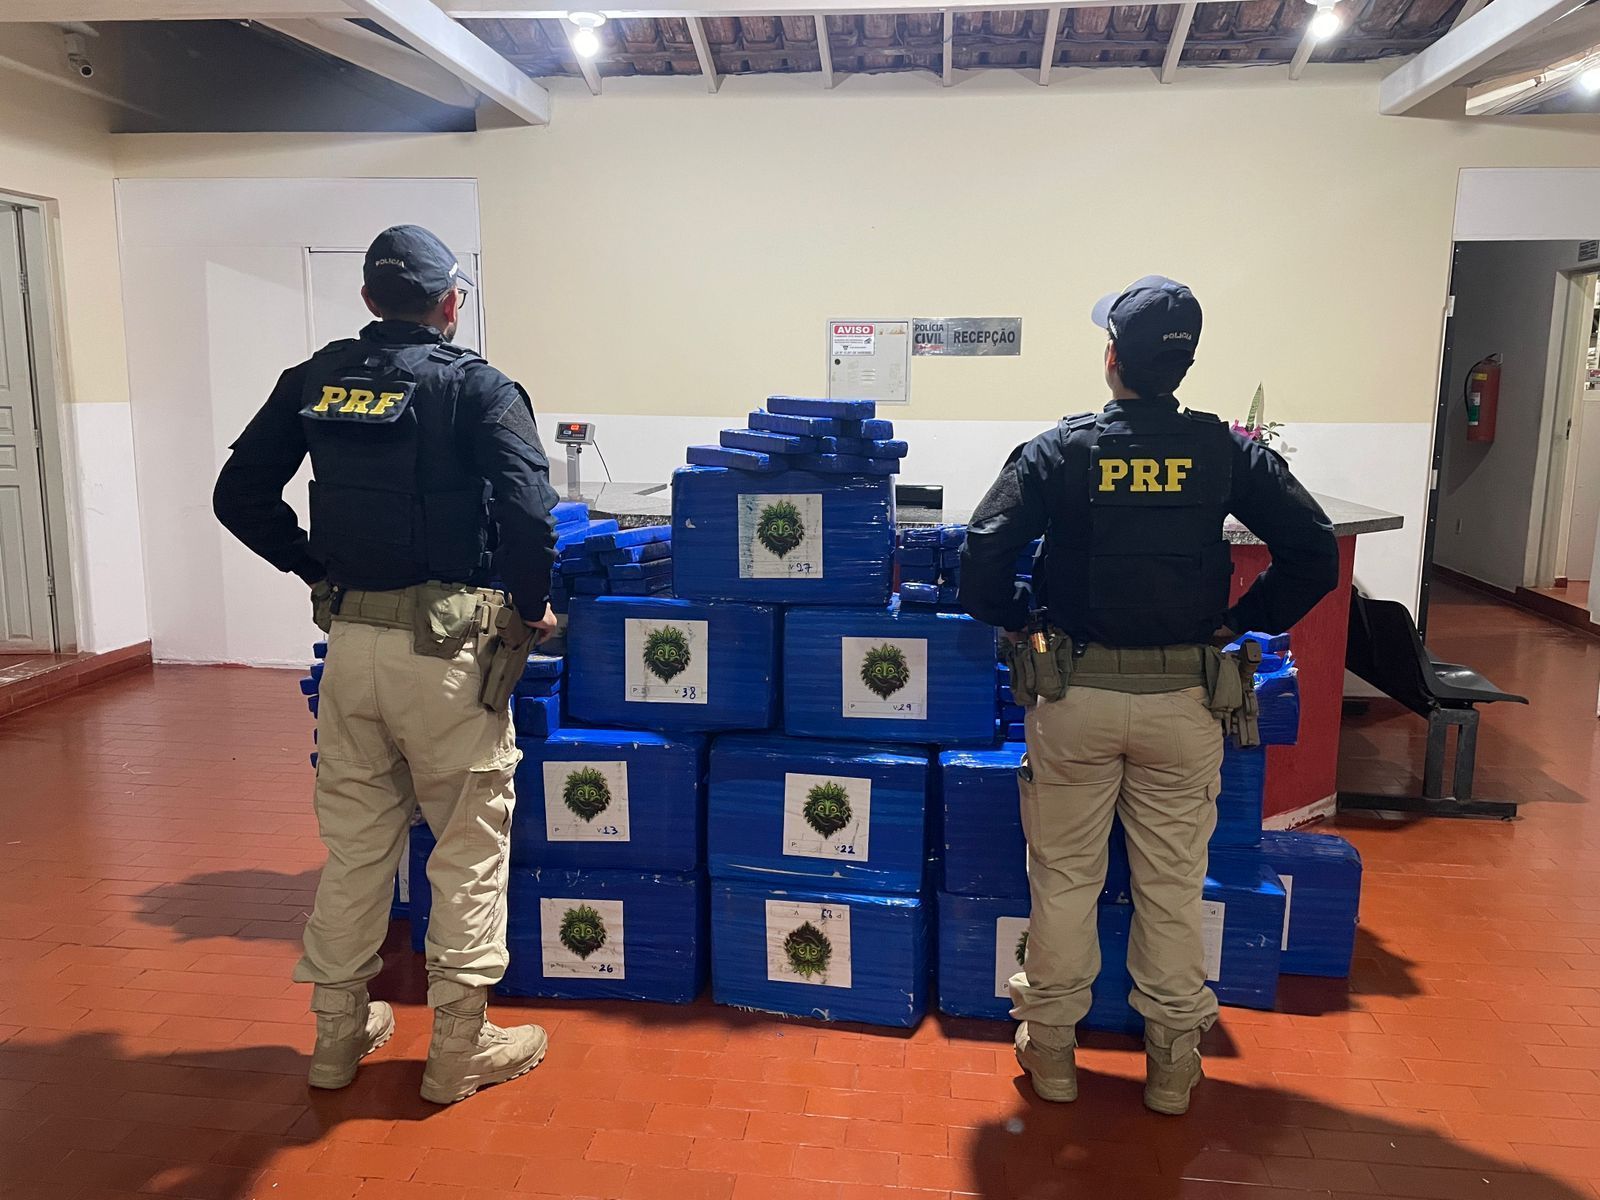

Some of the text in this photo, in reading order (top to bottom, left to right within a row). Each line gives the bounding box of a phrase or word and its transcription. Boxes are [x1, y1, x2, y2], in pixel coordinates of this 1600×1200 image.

[837, 326, 870, 334] AVISO
[914, 333, 944, 344] CIVIL
[953, 328, 1016, 347] RECEPÇÃO
[312, 386, 404, 415] PRF
[1098, 458, 1193, 492] PRF
[796, 563, 813, 573] 27
[682, 686, 696, 699] 38
[898, 703, 912, 711] 29
[603, 826, 618, 835] 13
[840, 844, 855, 855] 22
[599, 963, 614, 973] 26
